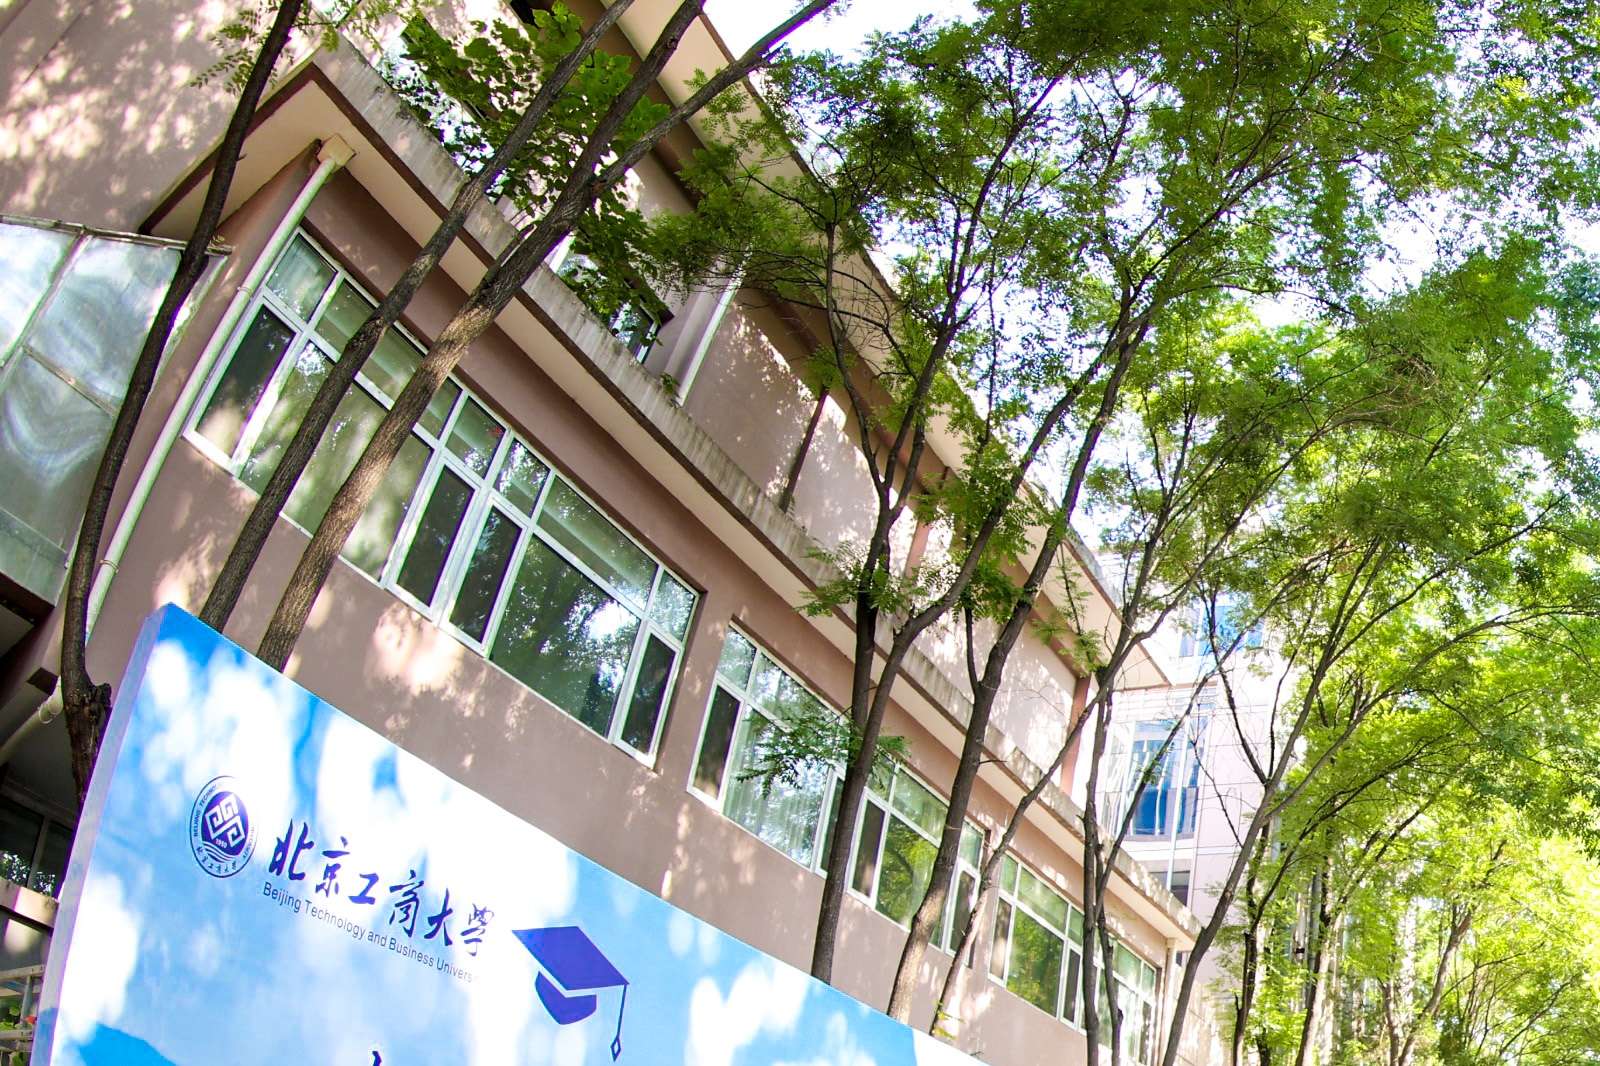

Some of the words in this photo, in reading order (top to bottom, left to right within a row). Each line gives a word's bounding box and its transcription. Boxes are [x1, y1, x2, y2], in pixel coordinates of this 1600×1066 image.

[262, 881, 302, 914] Beijing
[304, 899, 367, 940] Technology
[367, 930, 388, 948] and
[388, 937, 435, 968] Business
